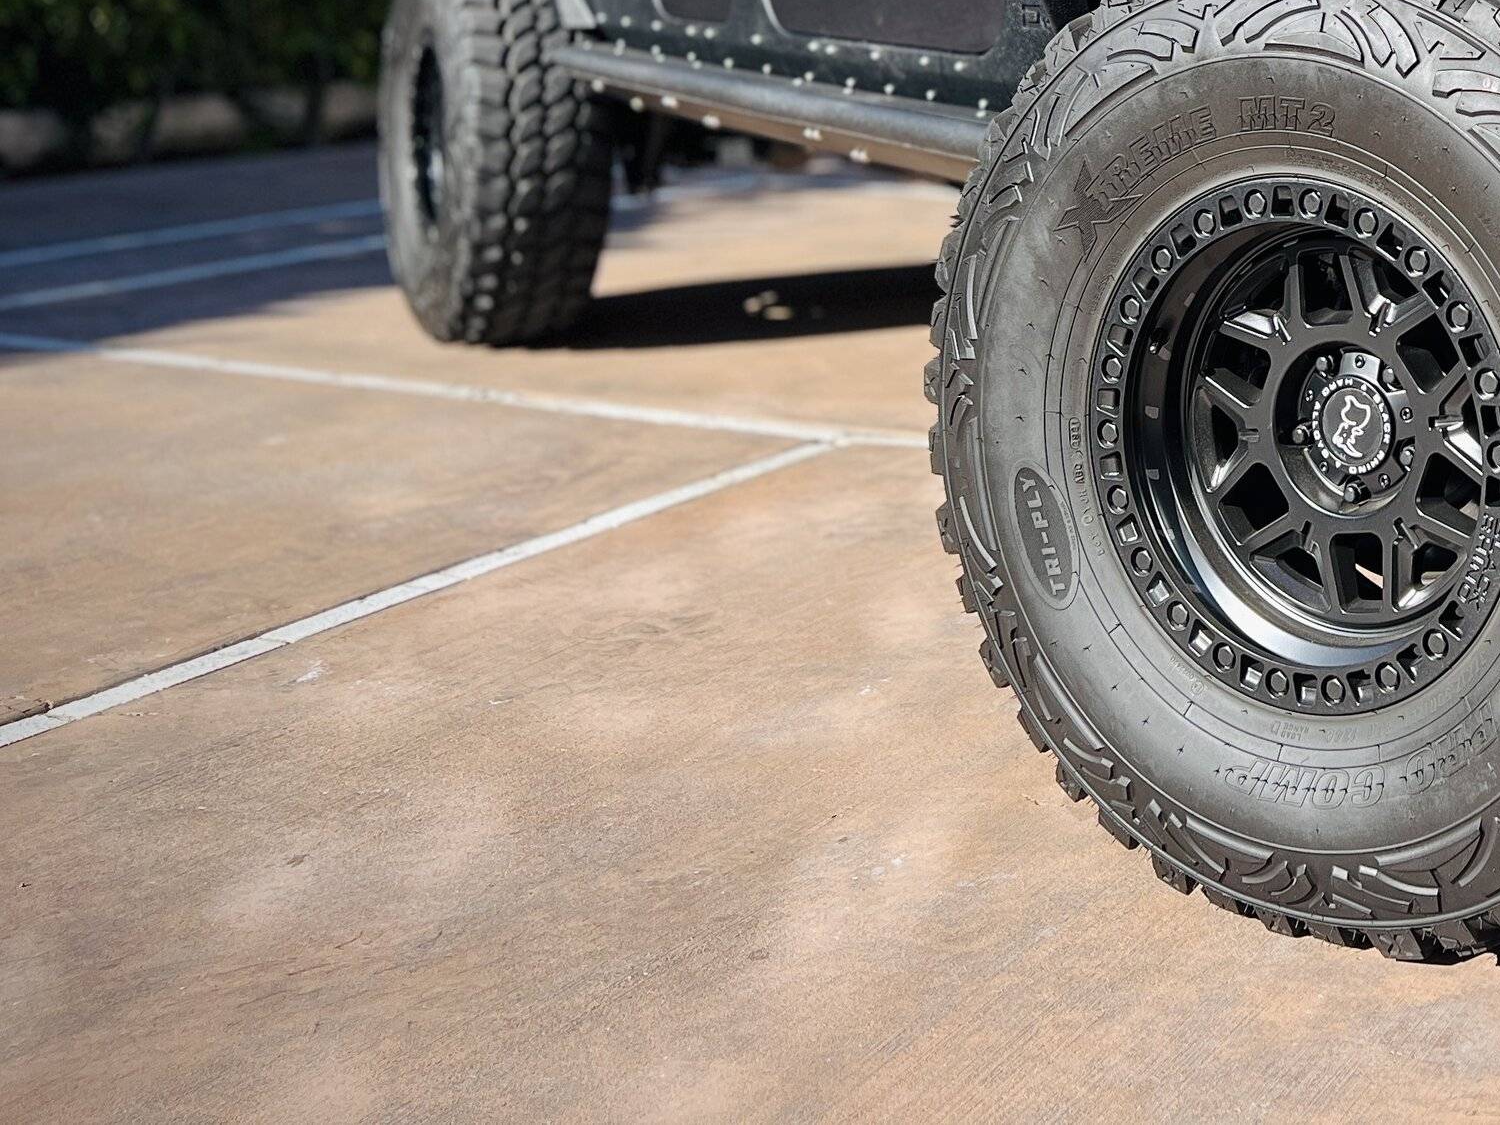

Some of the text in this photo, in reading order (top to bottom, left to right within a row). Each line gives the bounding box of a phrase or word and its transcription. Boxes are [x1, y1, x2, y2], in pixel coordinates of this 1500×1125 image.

[1053, 105, 1216, 262] XTREME
[1238, 95, 1336, 137] MT2
[1348, 394, 1391, 475] BLACK RHINO
[1020, 477, 1067, 596] TRI-PLY
[1224, 758, 1386, 810] COMP
[1405, 700, 1500, 795] PRO
